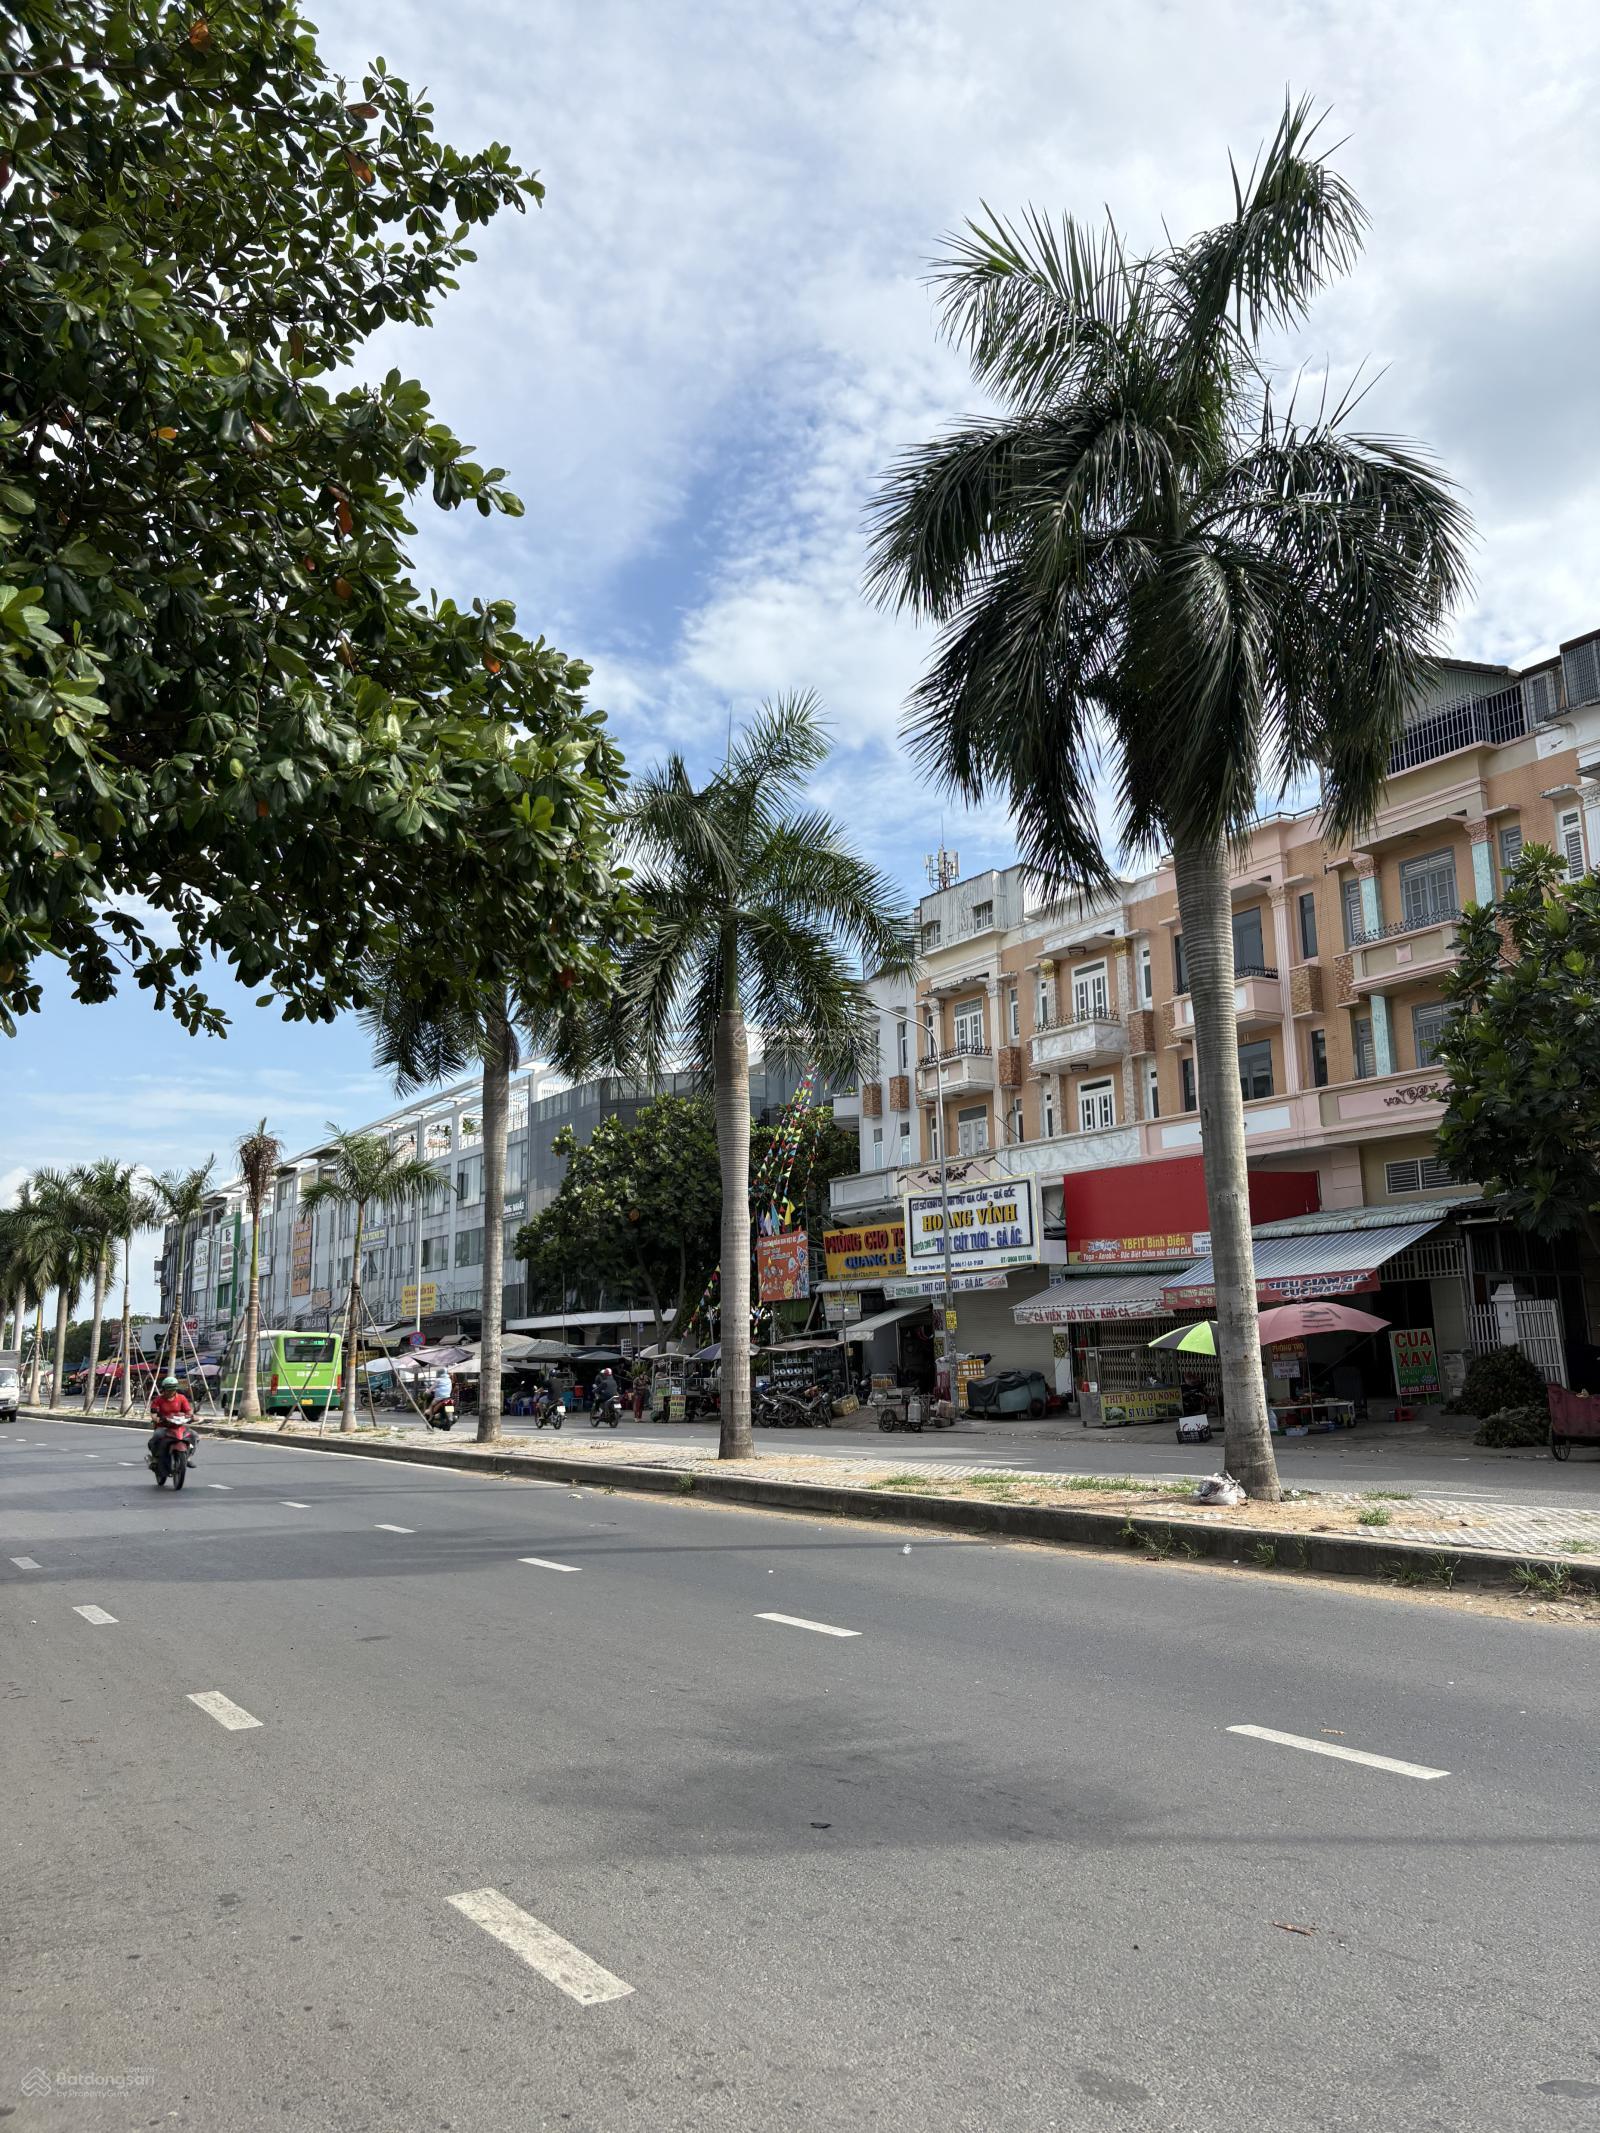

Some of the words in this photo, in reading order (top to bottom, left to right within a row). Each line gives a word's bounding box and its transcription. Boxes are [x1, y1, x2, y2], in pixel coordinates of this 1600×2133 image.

[844, 1253, 887, 1270] QUANG
[1395, 1331, 1431, 1348] CUA
[1399, 1351, 1432, 1367] XAY
